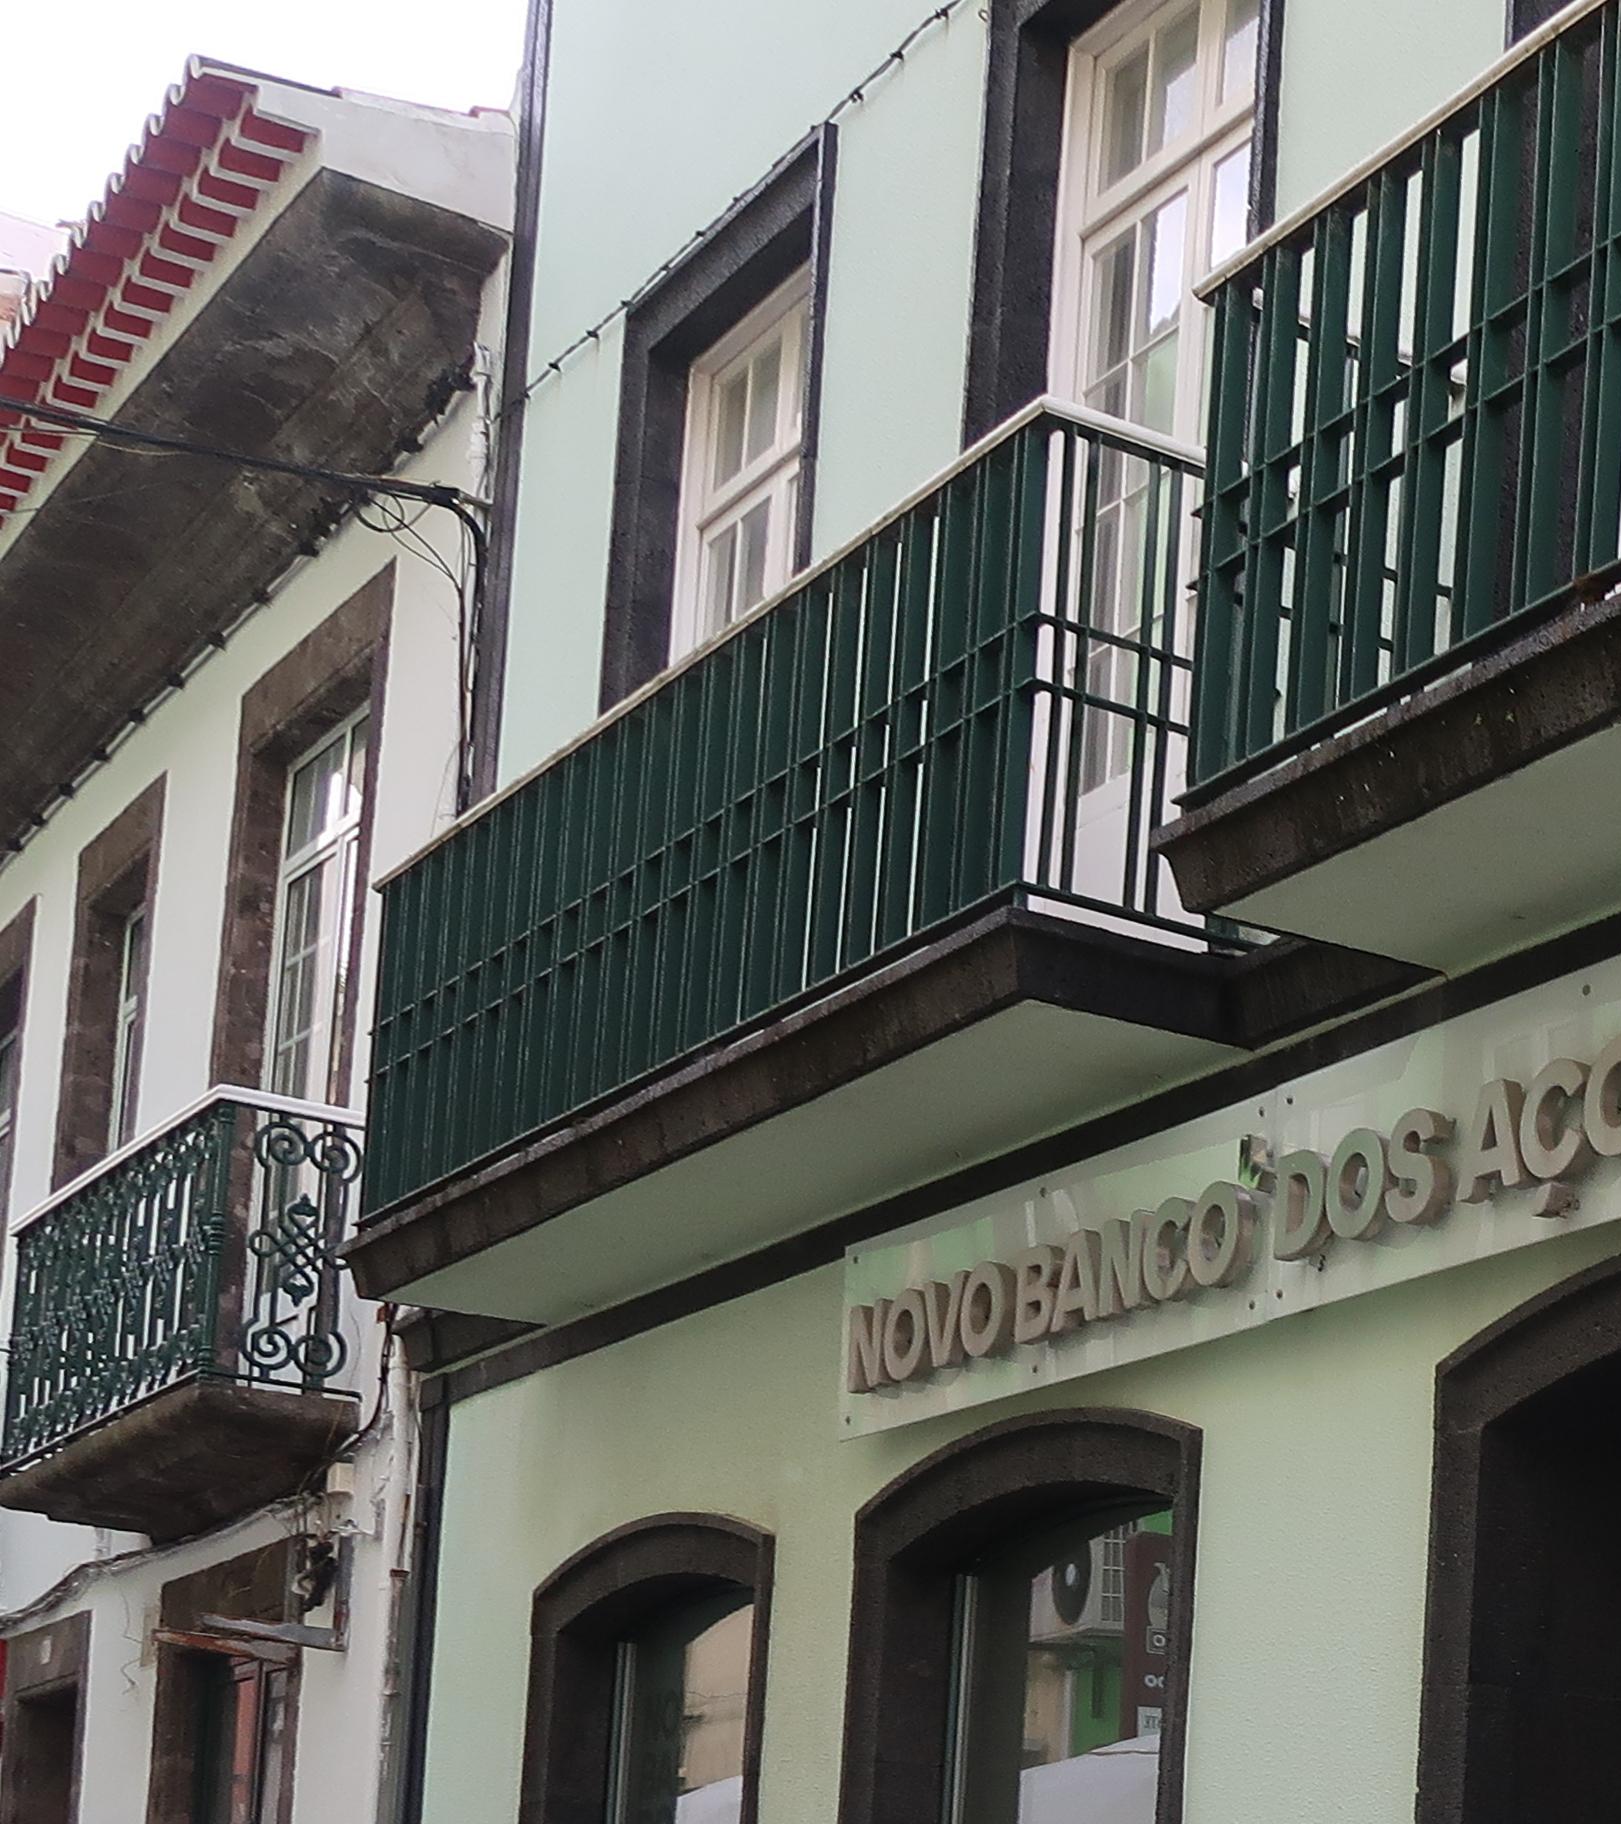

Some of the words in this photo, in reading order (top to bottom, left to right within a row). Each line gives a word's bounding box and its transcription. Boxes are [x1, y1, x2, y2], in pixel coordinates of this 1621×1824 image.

[847, 1261, 1017, 1394] NOVO
[1014, 1180, 1256, 1344] BANCO
[1273, 1108, 1455, 1261] DOS
